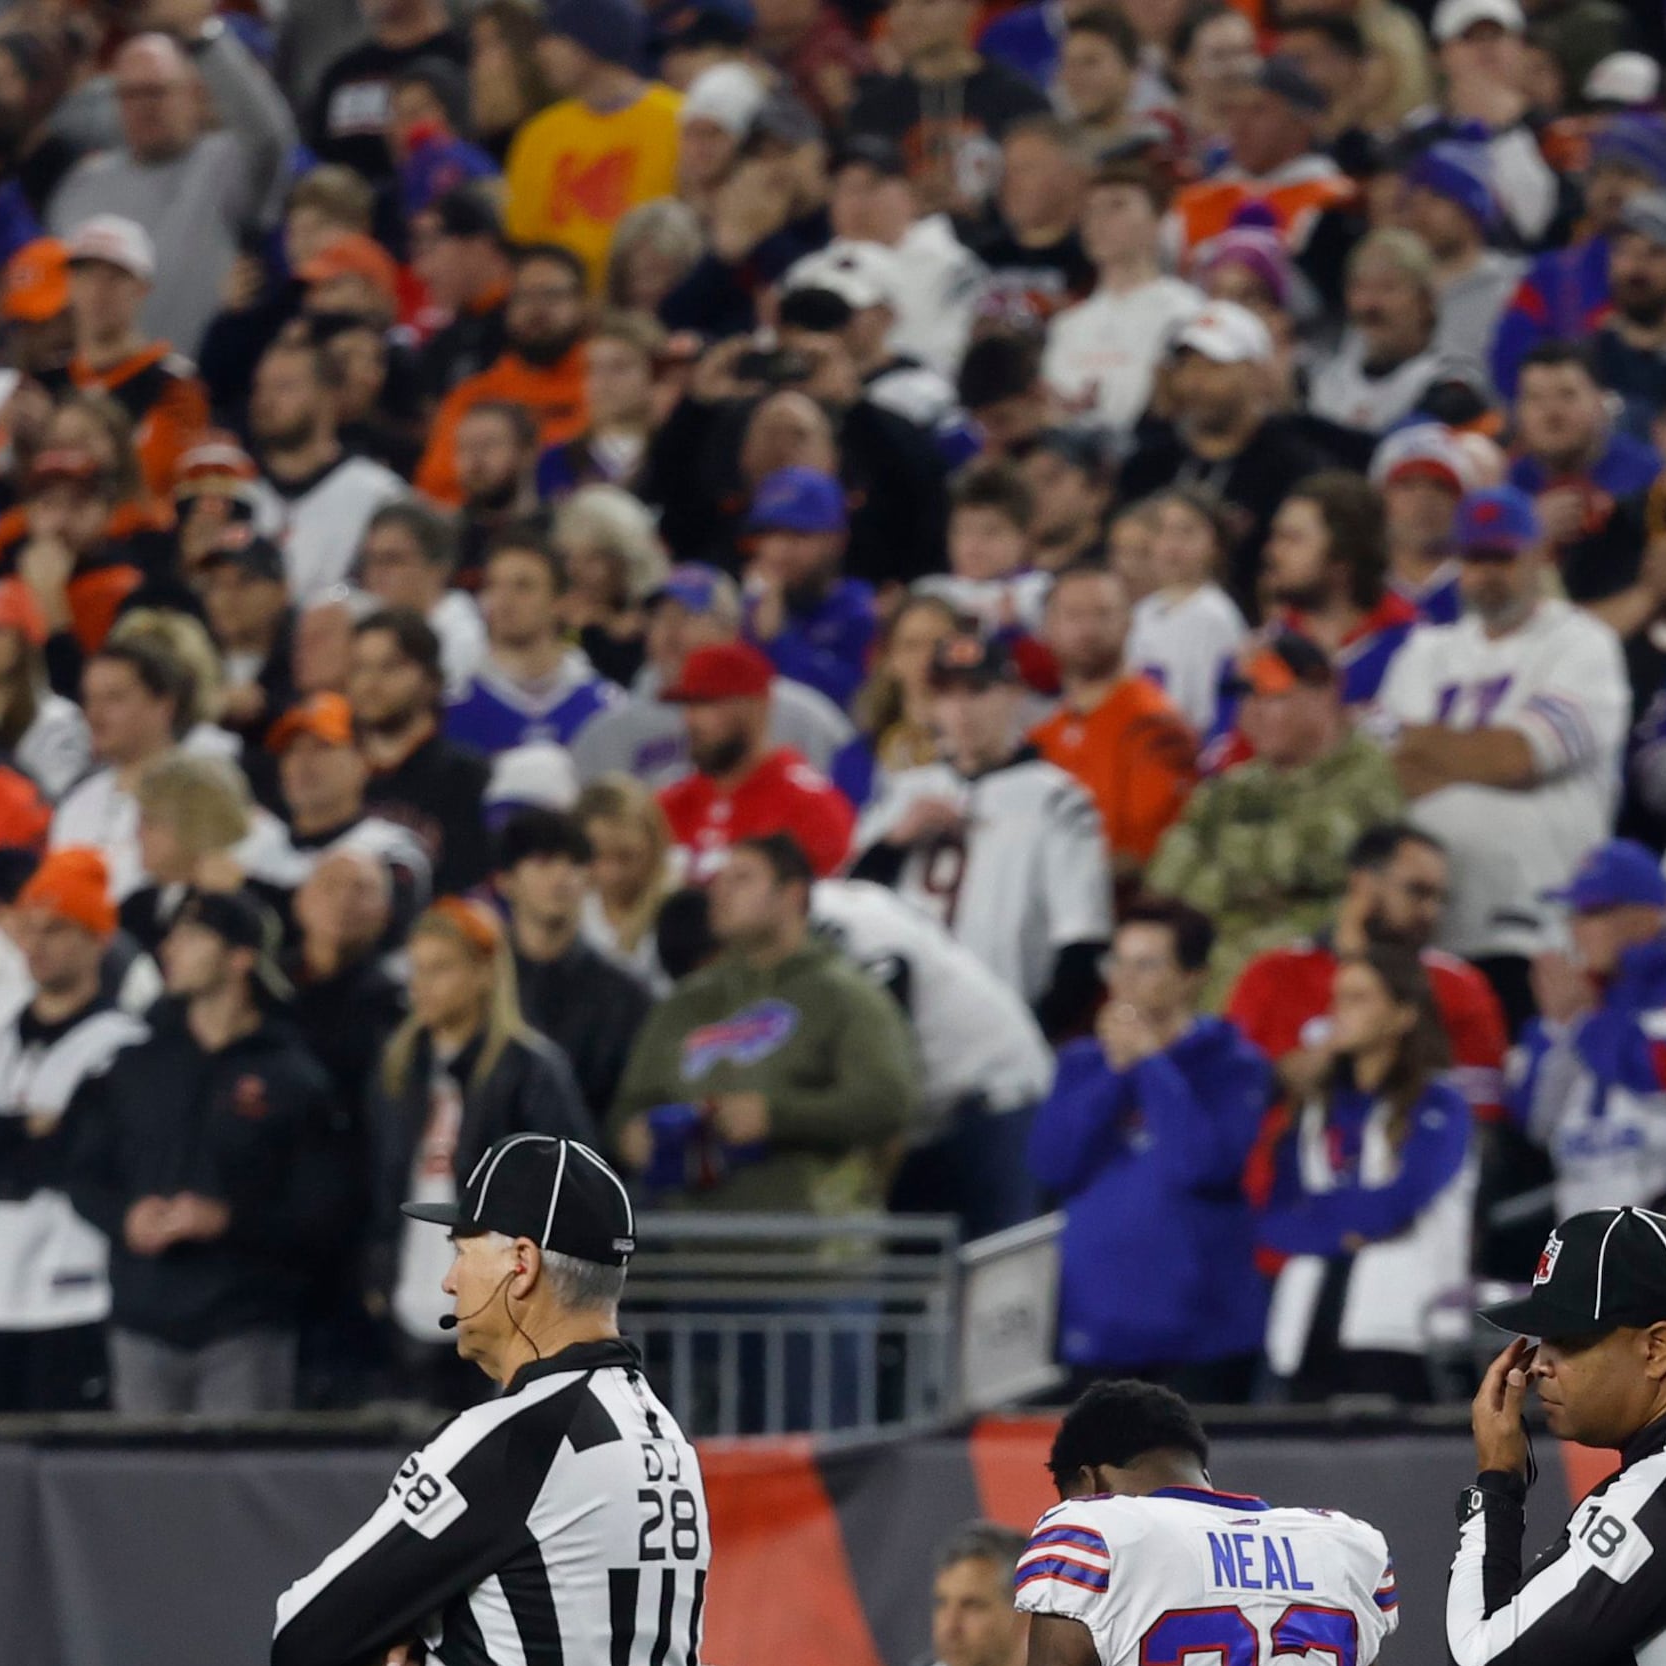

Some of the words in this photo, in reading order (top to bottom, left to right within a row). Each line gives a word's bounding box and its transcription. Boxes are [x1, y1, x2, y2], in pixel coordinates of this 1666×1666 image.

[637, 1488, 700, 1562] 28
[1579, 1504, 1628, 1559] 18
[1206, 1531, 1314, 1592] NEAL
